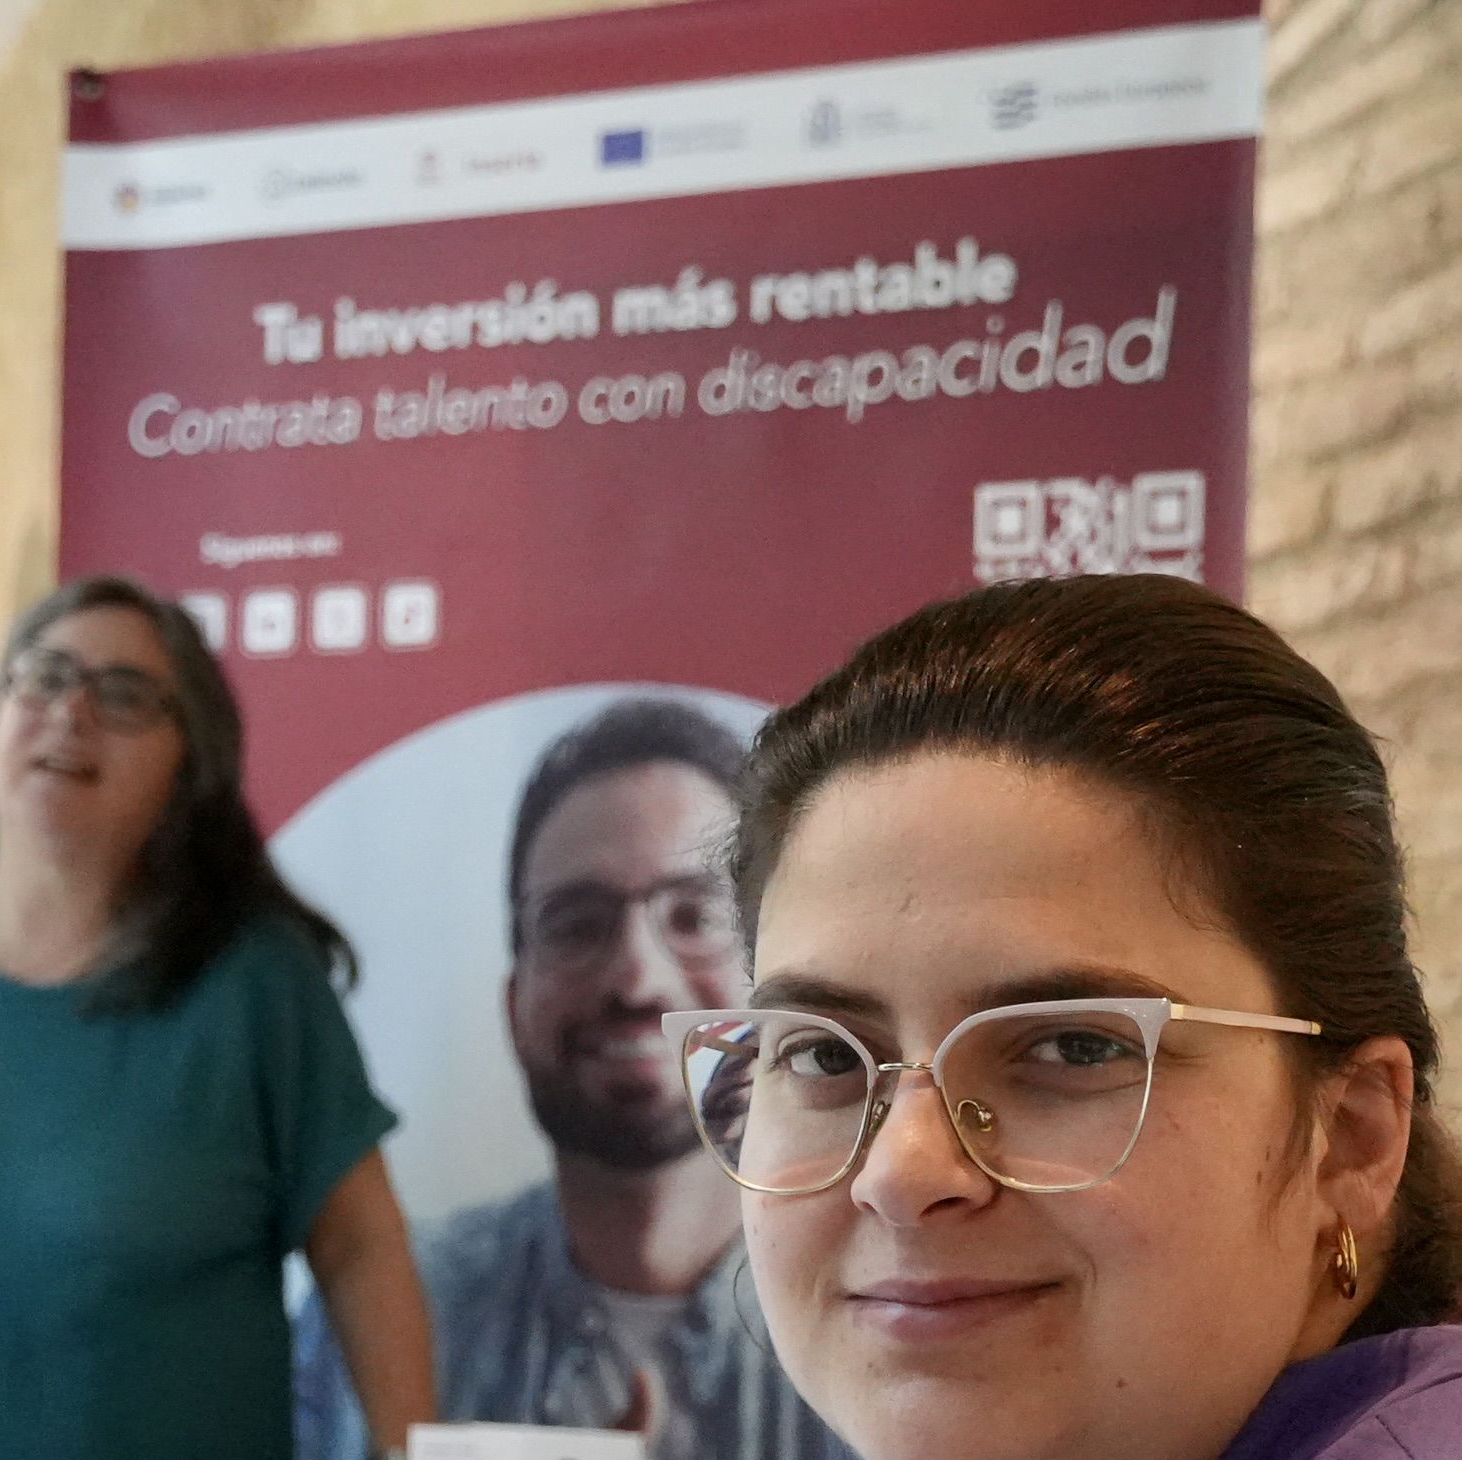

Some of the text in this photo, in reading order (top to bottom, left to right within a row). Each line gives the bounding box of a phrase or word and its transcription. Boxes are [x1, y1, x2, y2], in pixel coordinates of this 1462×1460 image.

[127, 283, 1178, 459] Contrata talento con discapacidad
[253, 236, 1019, 365] Tu inversión más rentable
